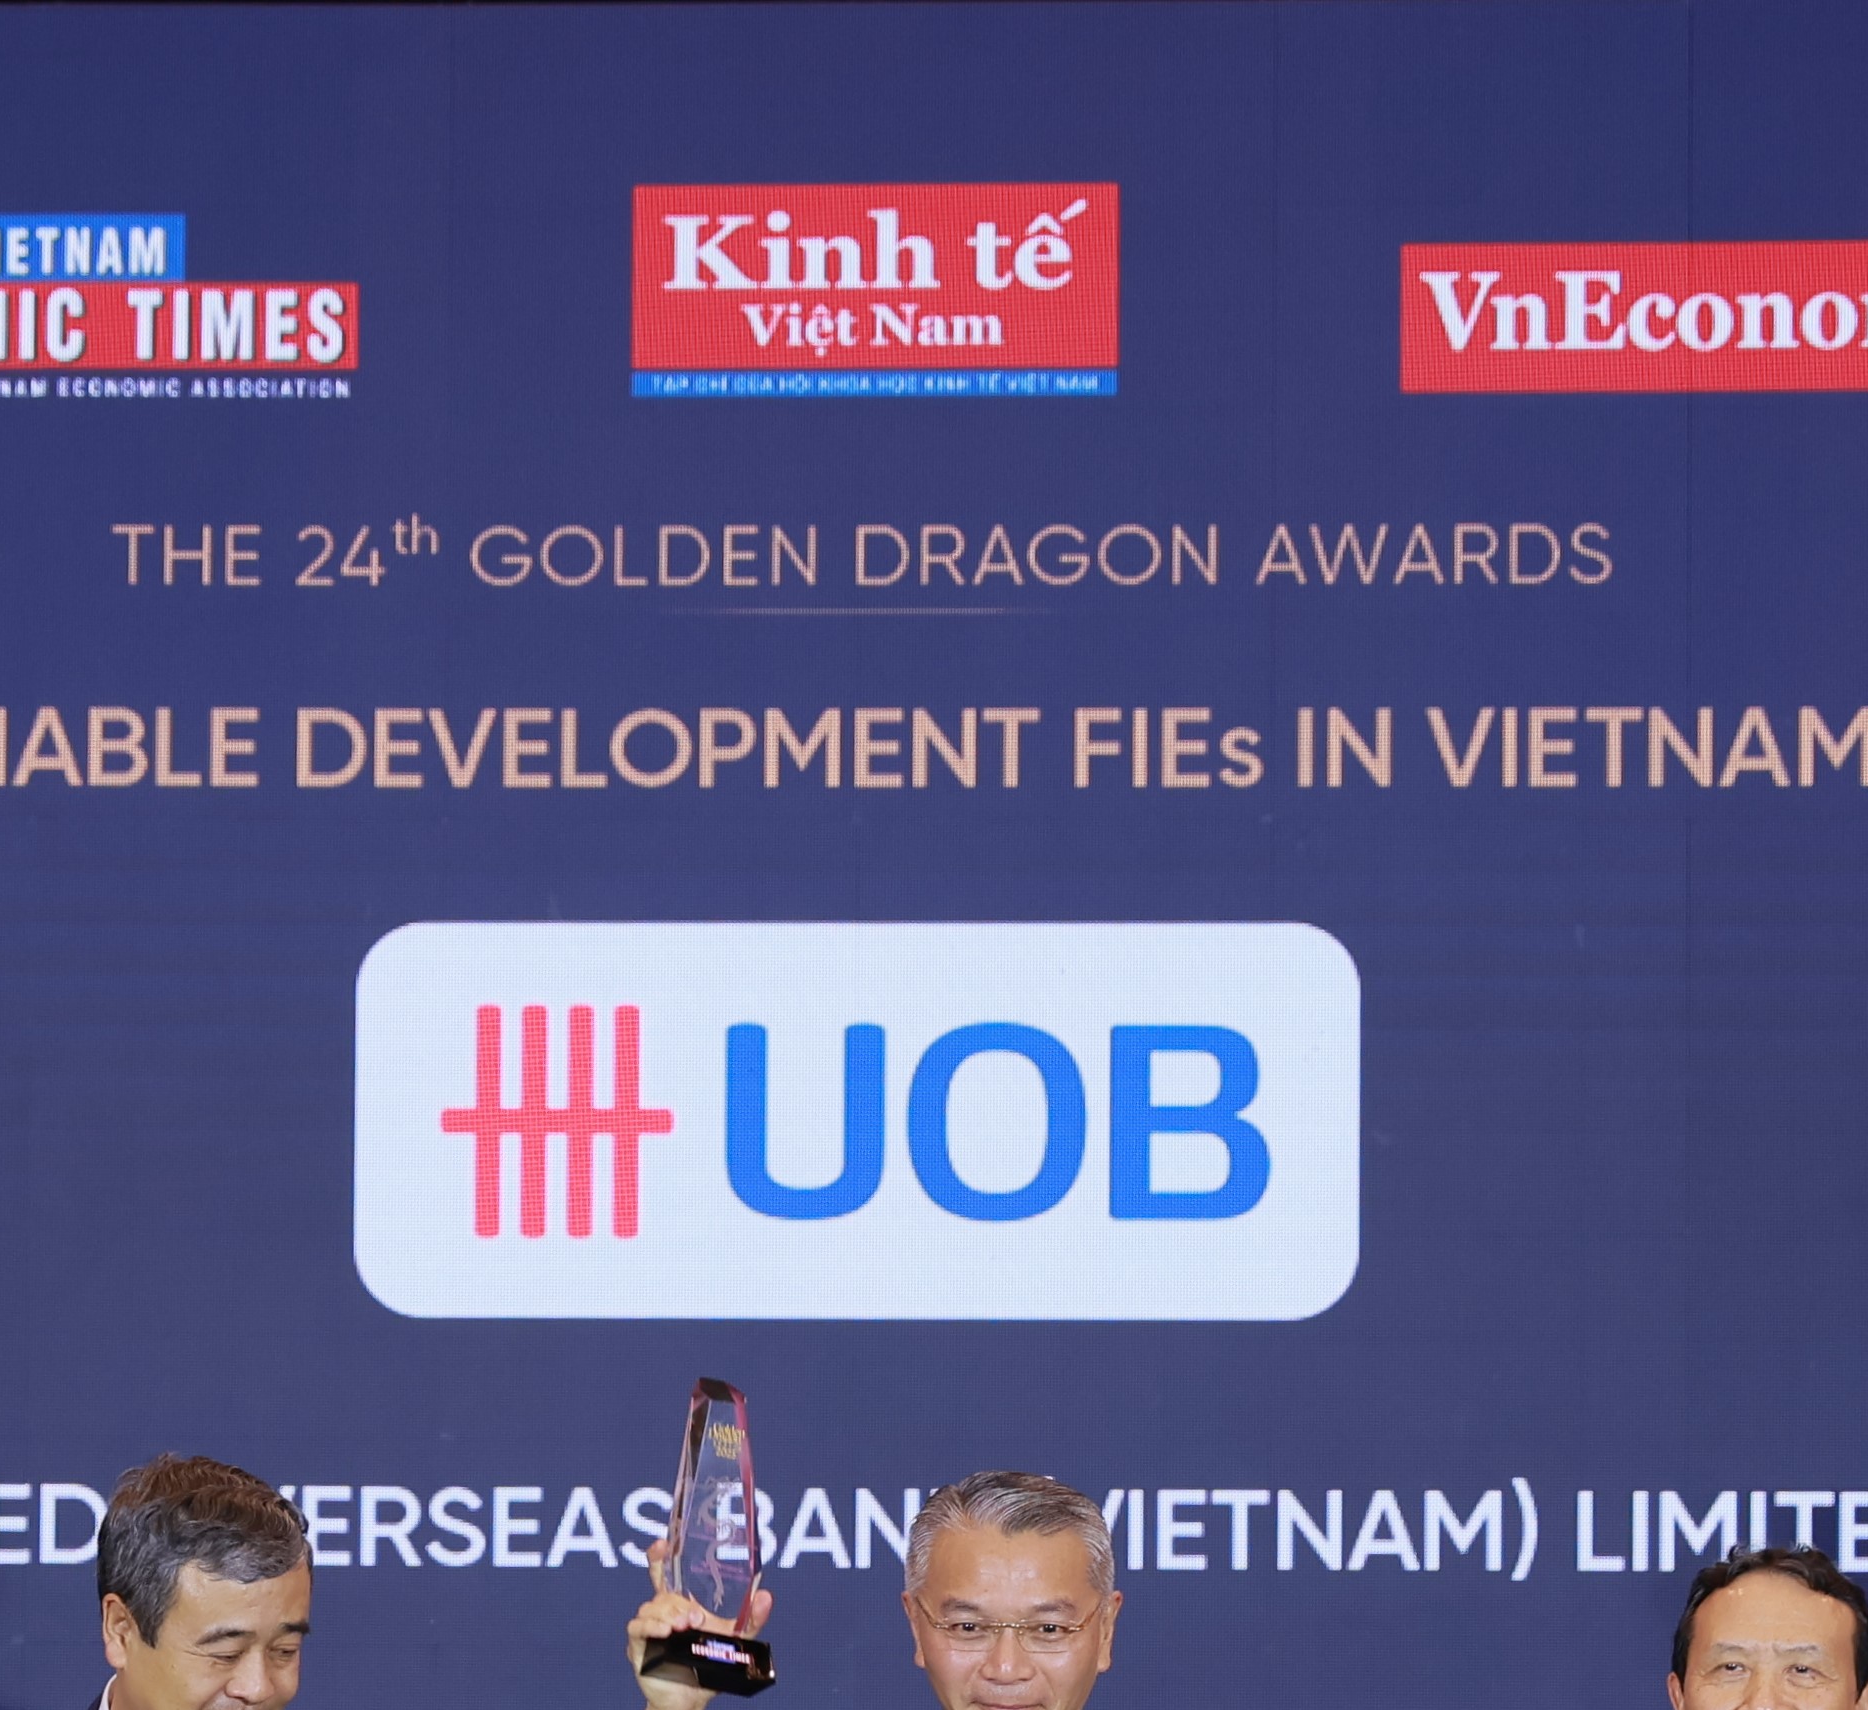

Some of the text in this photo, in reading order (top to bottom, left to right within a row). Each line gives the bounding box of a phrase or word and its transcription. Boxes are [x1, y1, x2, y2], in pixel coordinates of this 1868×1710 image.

[664, 200, 1088, 291] Kinh tế
[127, 288, 344, 363] TIMES
[742, 302, 1003, 357] Việt Nam
[57, 377, 180, 398] ECONOMIC
[191, 377, 350, 399] ASSOCIATION
[112, 512, 1613, 587] THE 24th GOLDEN DRAGON AWARDS
[296, 707, 1041, 788] DEVELOPMENT
[1074, 707, 1265, 788] FIEs
[1297, 706, 1392, 788] IN
[725, 1021, 1272, 1222] UOB
